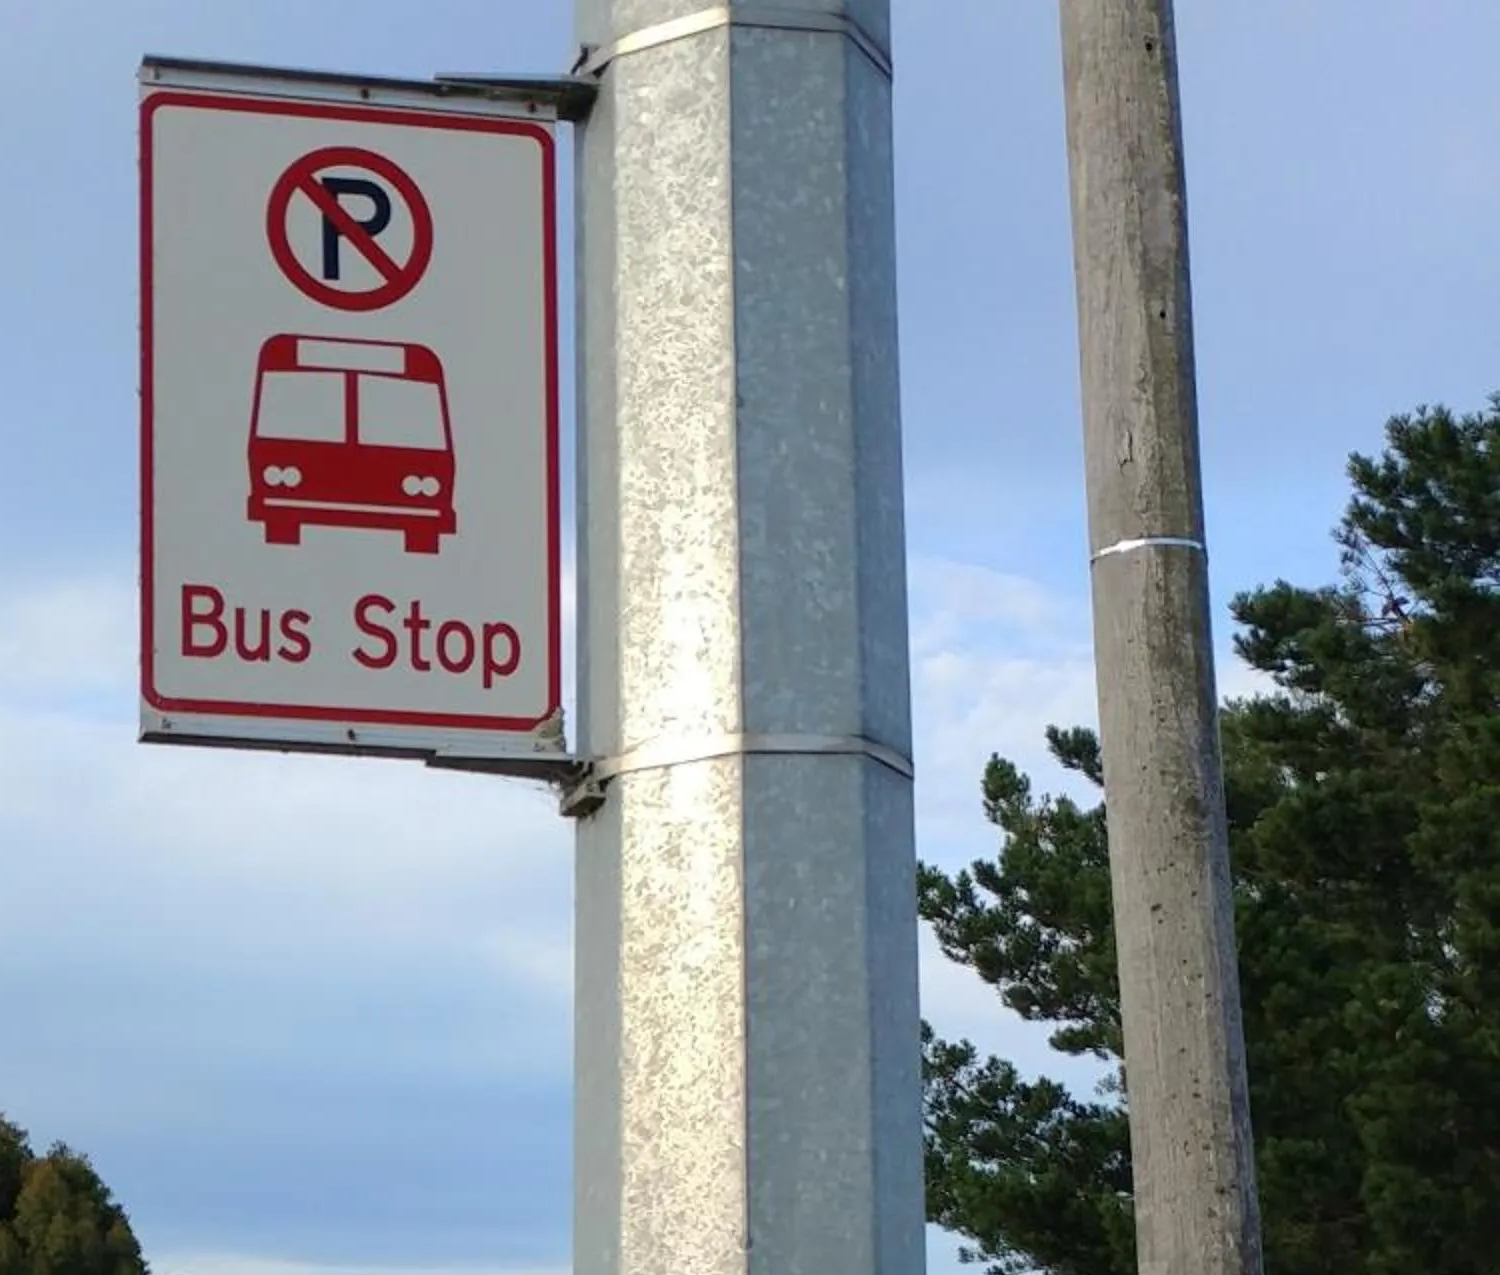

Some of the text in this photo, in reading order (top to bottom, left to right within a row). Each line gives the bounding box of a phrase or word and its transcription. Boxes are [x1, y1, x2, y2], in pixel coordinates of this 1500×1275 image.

[321, 177, 391, 280] P
[180, 584, 522, 689] Bus Stop
